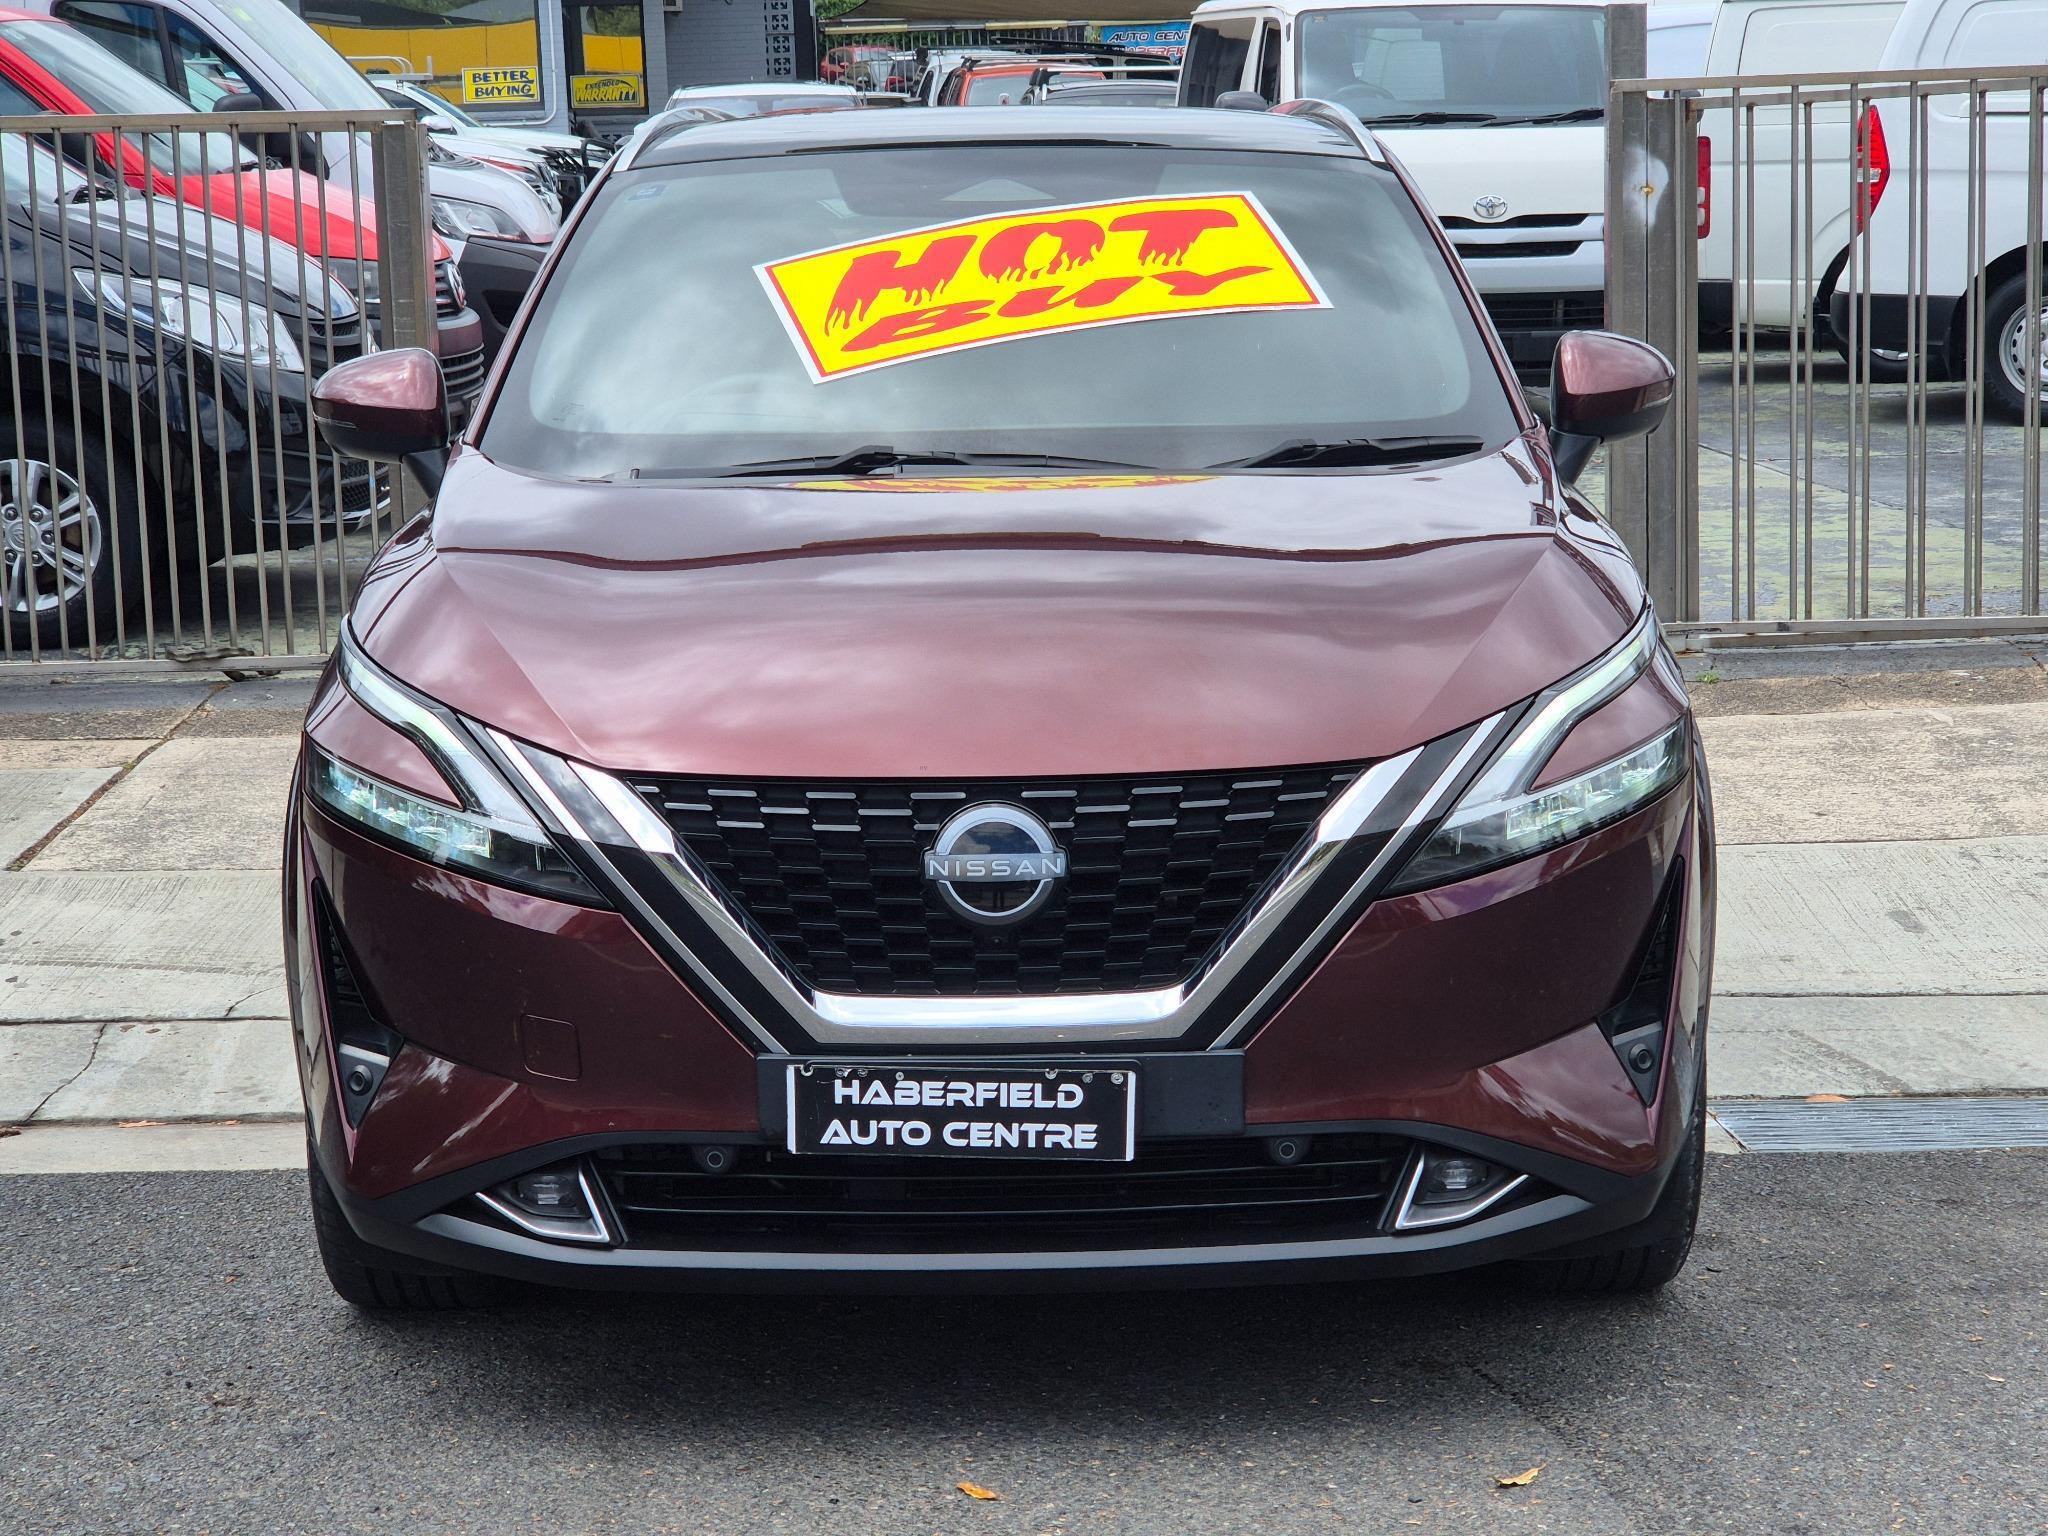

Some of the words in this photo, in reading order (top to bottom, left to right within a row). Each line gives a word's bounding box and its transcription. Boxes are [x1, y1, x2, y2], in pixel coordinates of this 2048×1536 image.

[1108, 31, 1150, 43] AUTO
[472, 71, 530, 83] BETTER
[585, 79, 621, 90] EXTENDED
[475, 84, 532, 97] BUYING
[576, 87, 635, 102] WARRANTY
[825, 209, 1238, 336] HOT
[840, 265, 1274, 353] BUY
[929, 857, 1061, 877] NISSAN
[834, 1079, 1084, 1109] HABERFIELD
[820, 1119, 931, 1146] AUTO
[942, 1122, 1098, 1149] CENTRE
